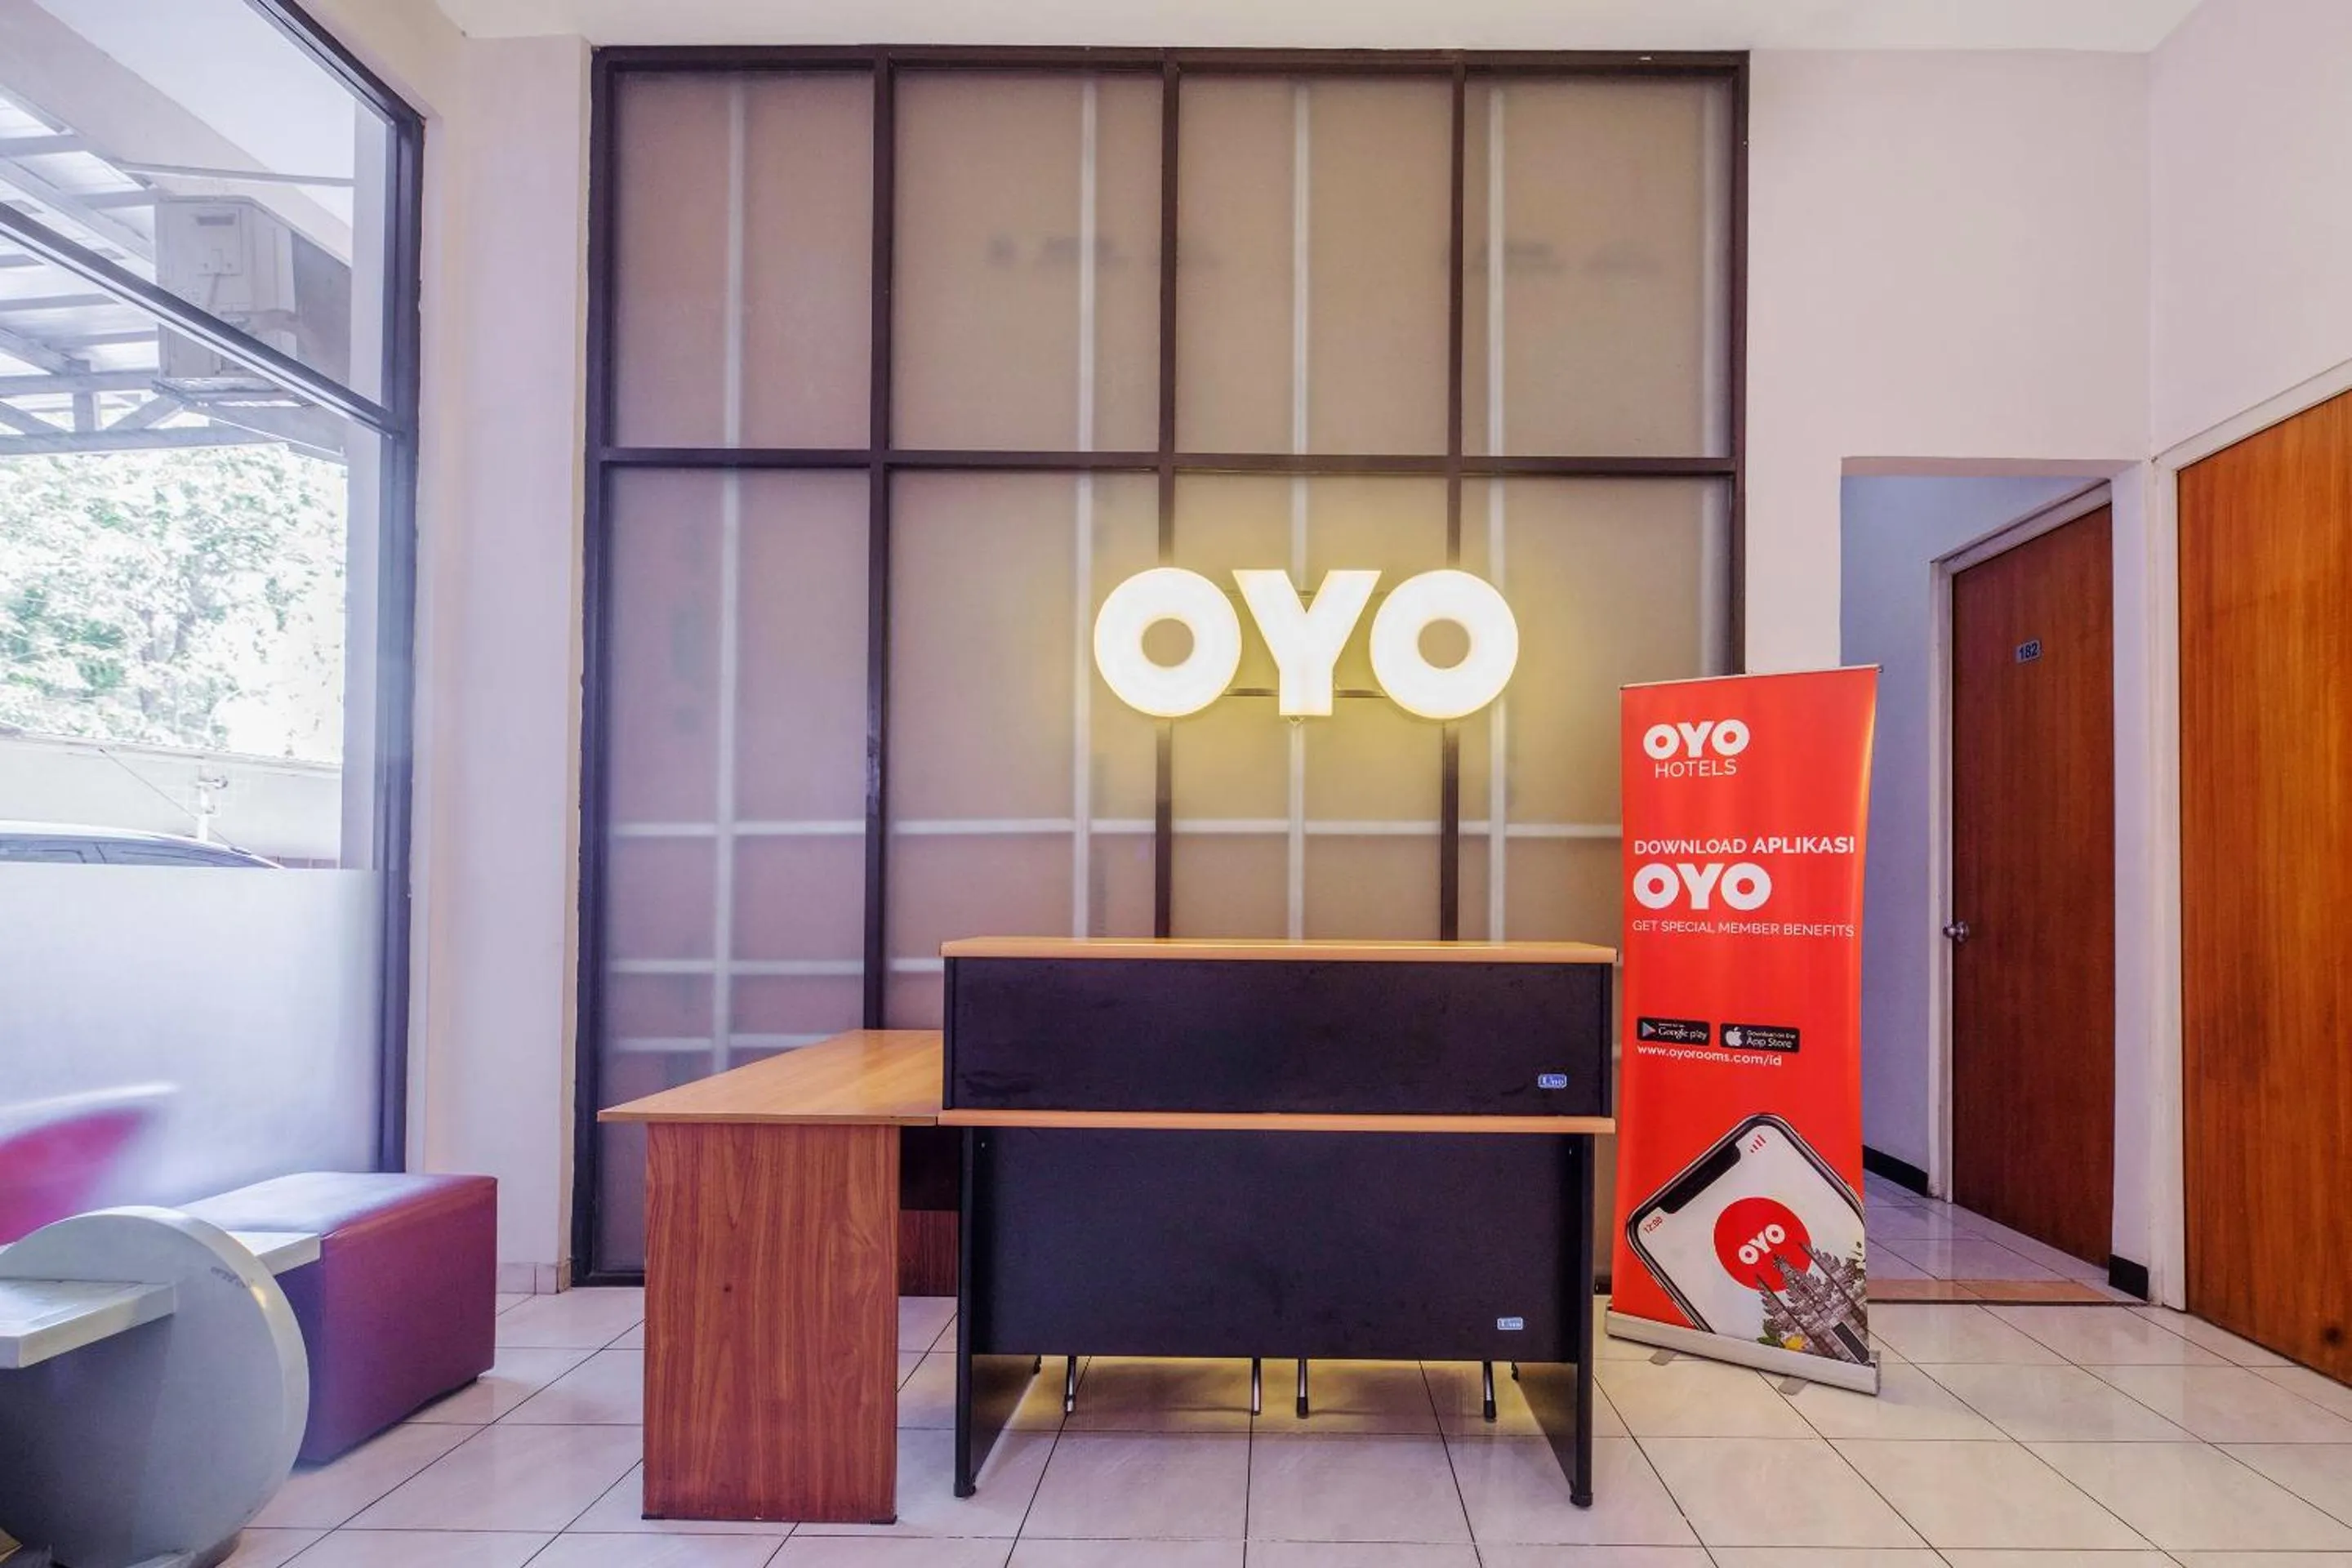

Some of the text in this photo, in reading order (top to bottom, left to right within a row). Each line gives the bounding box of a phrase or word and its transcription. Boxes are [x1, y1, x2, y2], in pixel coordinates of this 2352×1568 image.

[1094, 567, 1519, 719] OYO
[2019, 642, 2038, 660] 182
[1643, 719, 1751, 760] OYO
[1655, 759, 1737, 778] HOTELS
[1634, 836, 1855, 855] DOWNLOAD APLIKASI
[1633, 862, 1772, 911] OYO
[1633, 920, 1855, 938] GET SPECIAL MEMBER BENEFITS
[1659, 1027, 1689, 1040] Google
[1747, 1036, 1793, 1049] App Store
[1637, 1045, 1782, 1067] www.oyorooms.com/id
[1738, 1224, 1786, 1265] OYO
